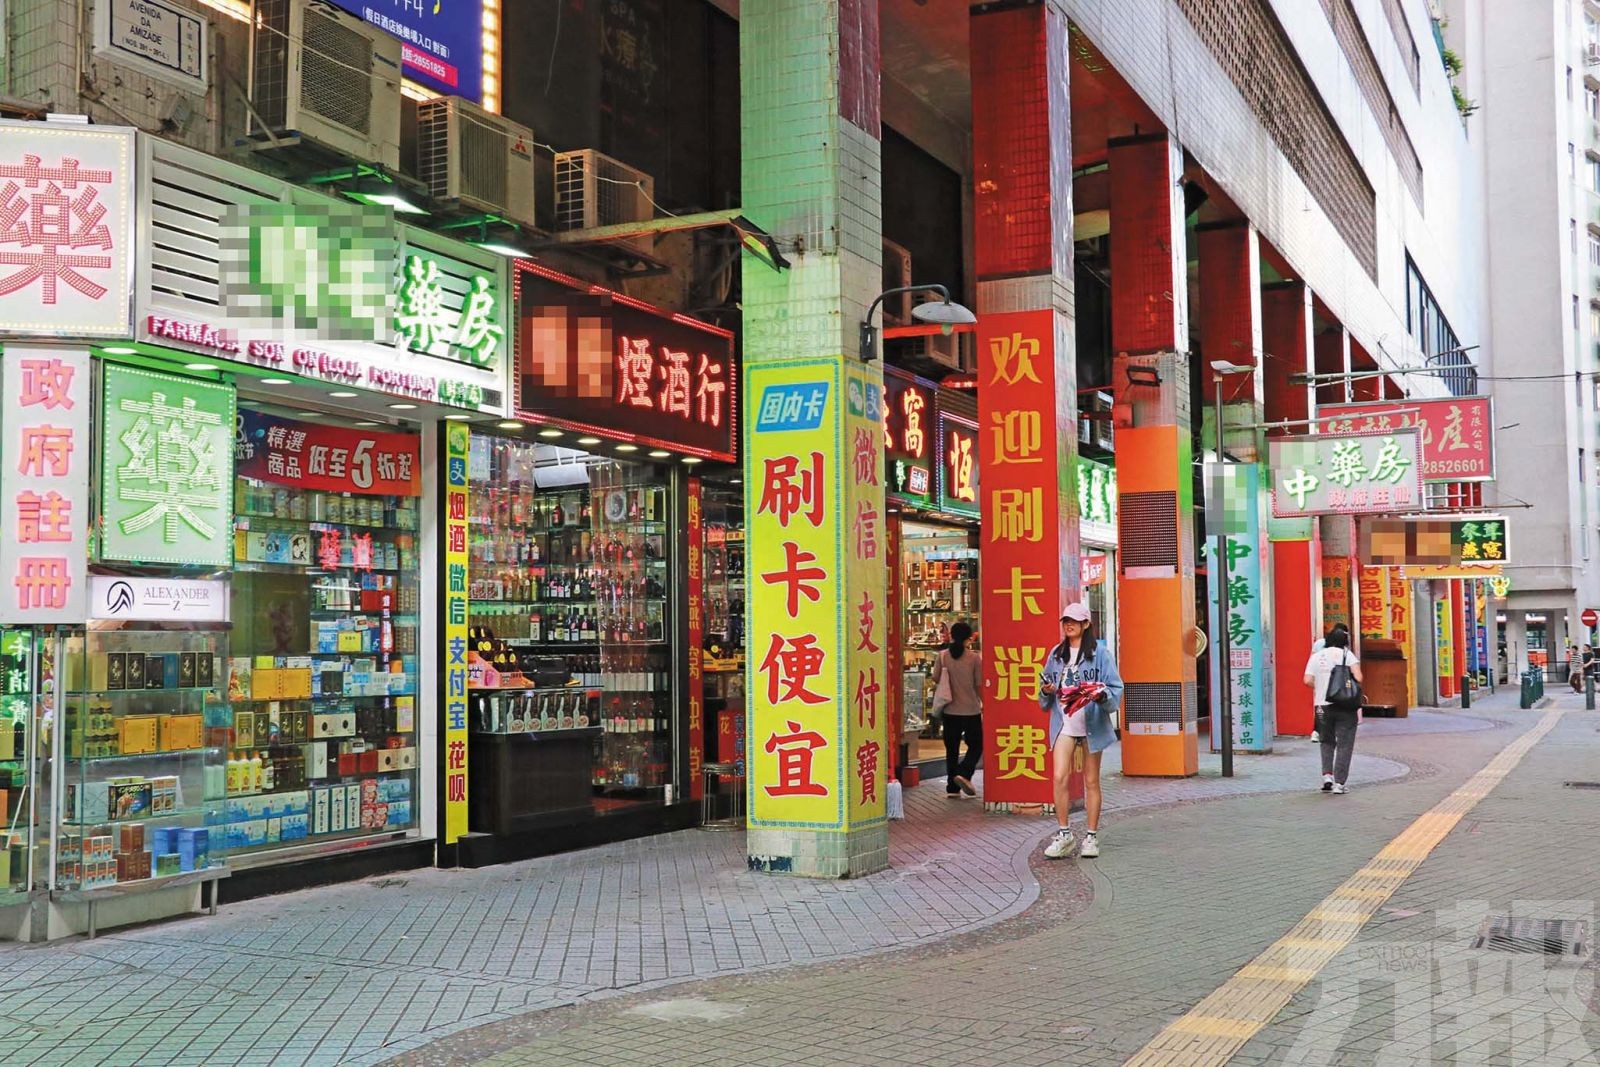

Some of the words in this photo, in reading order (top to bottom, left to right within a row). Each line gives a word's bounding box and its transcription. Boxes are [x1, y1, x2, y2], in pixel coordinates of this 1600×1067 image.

[129, 0, 162, 20] AVENIDA
[140, 16, 152, 29] DA
[129, 25, 162, 46] AMIZADE
[394, 254, 504, 364] 藥房
[617, 335, 726, 428] 煙酒行
[759, 388, 824, 426] 国内卡
[267, 425, 307, 453] 精選
[308, 439, 413, 489] 低至5折起
[15, 358, 75, 610] 政府註冊
[116, 390, 224, 544] 藥
[268, 452, 302, 479] 商品
[1423, 458, 1485, 475] 28526601
[988, 331, 1051, 781] 欢迎刷卡消费
[143, 586, 210, 600] ALEXANDER
[172, 600, 181, 612] Z
[852, 425, 881, 806] 微信支付寶
[756, 450, 832, 797] 刷卡便宜
[448, 636, 466, 730] 支付宝
[1237, 672, 1254, 745] 環球藥品
